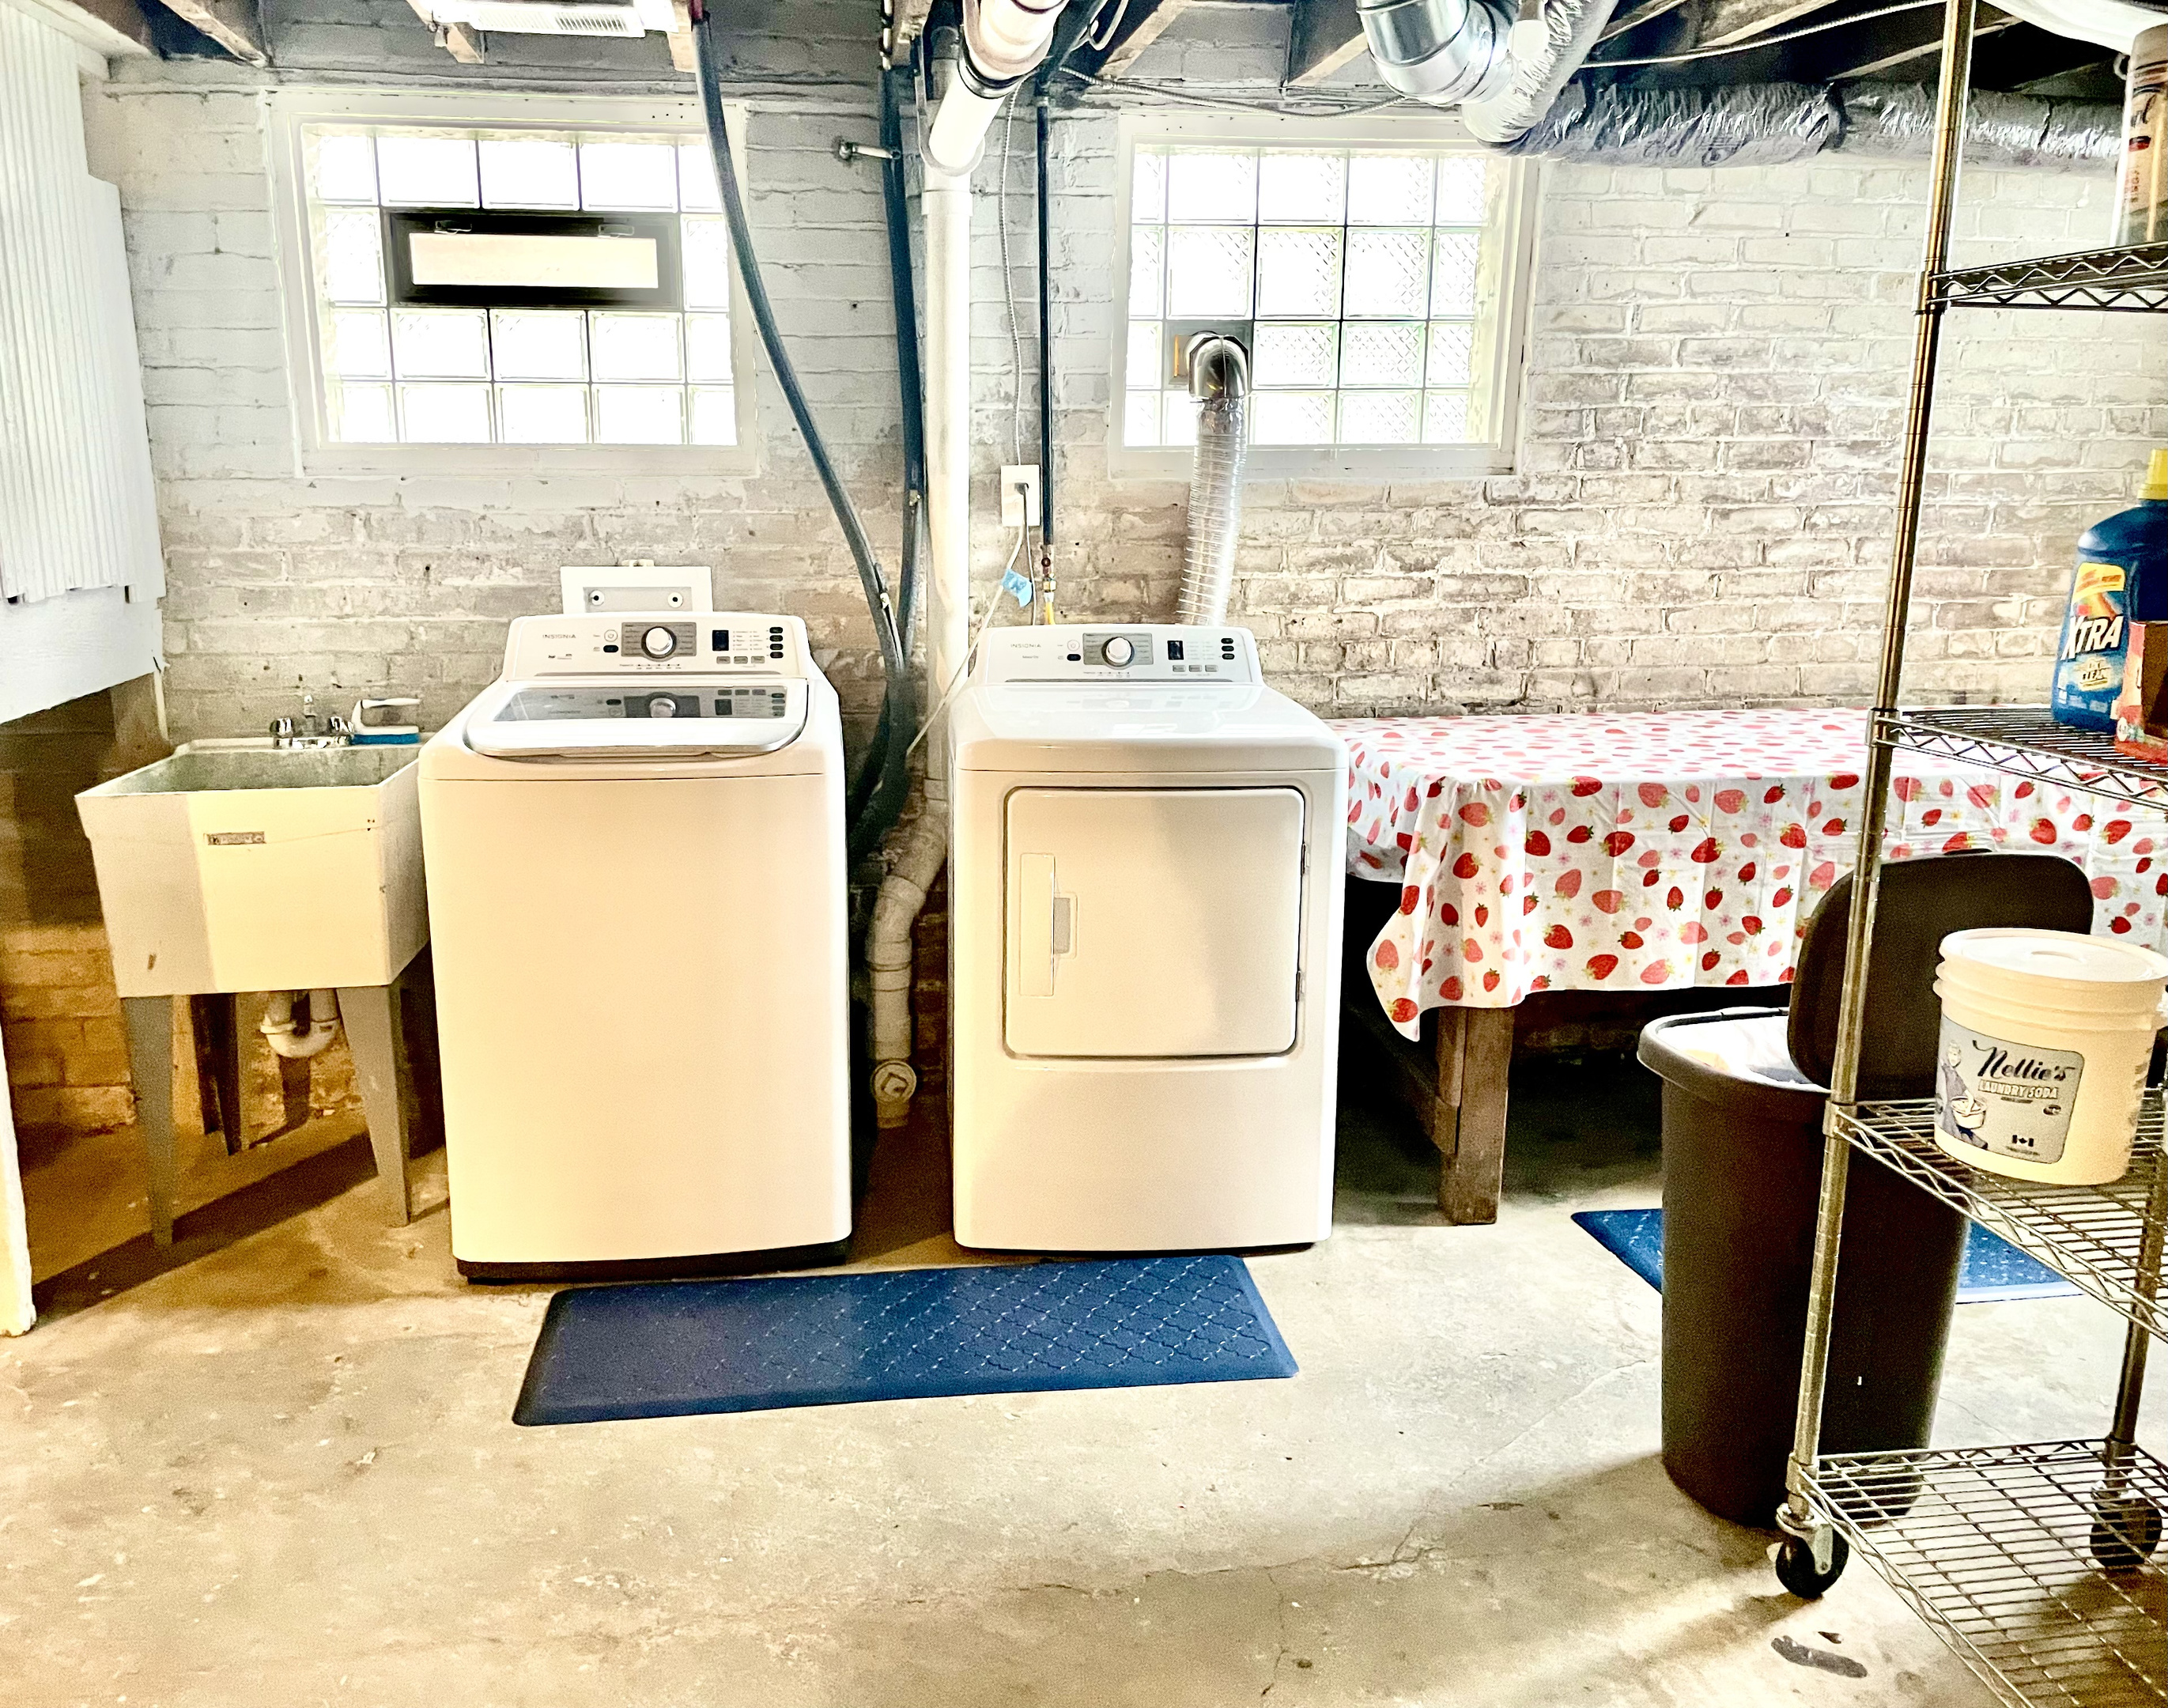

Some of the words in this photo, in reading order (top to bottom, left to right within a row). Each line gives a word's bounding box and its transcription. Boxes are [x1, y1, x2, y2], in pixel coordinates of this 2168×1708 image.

[2060, 614, 2125, 661] XTRA
[1972, 1039, 2076, 1082] Nellie's
[1978, 1079, 2027, 1098] LAUNDRY
[2027, 1086, 2058, 1099] SODA
